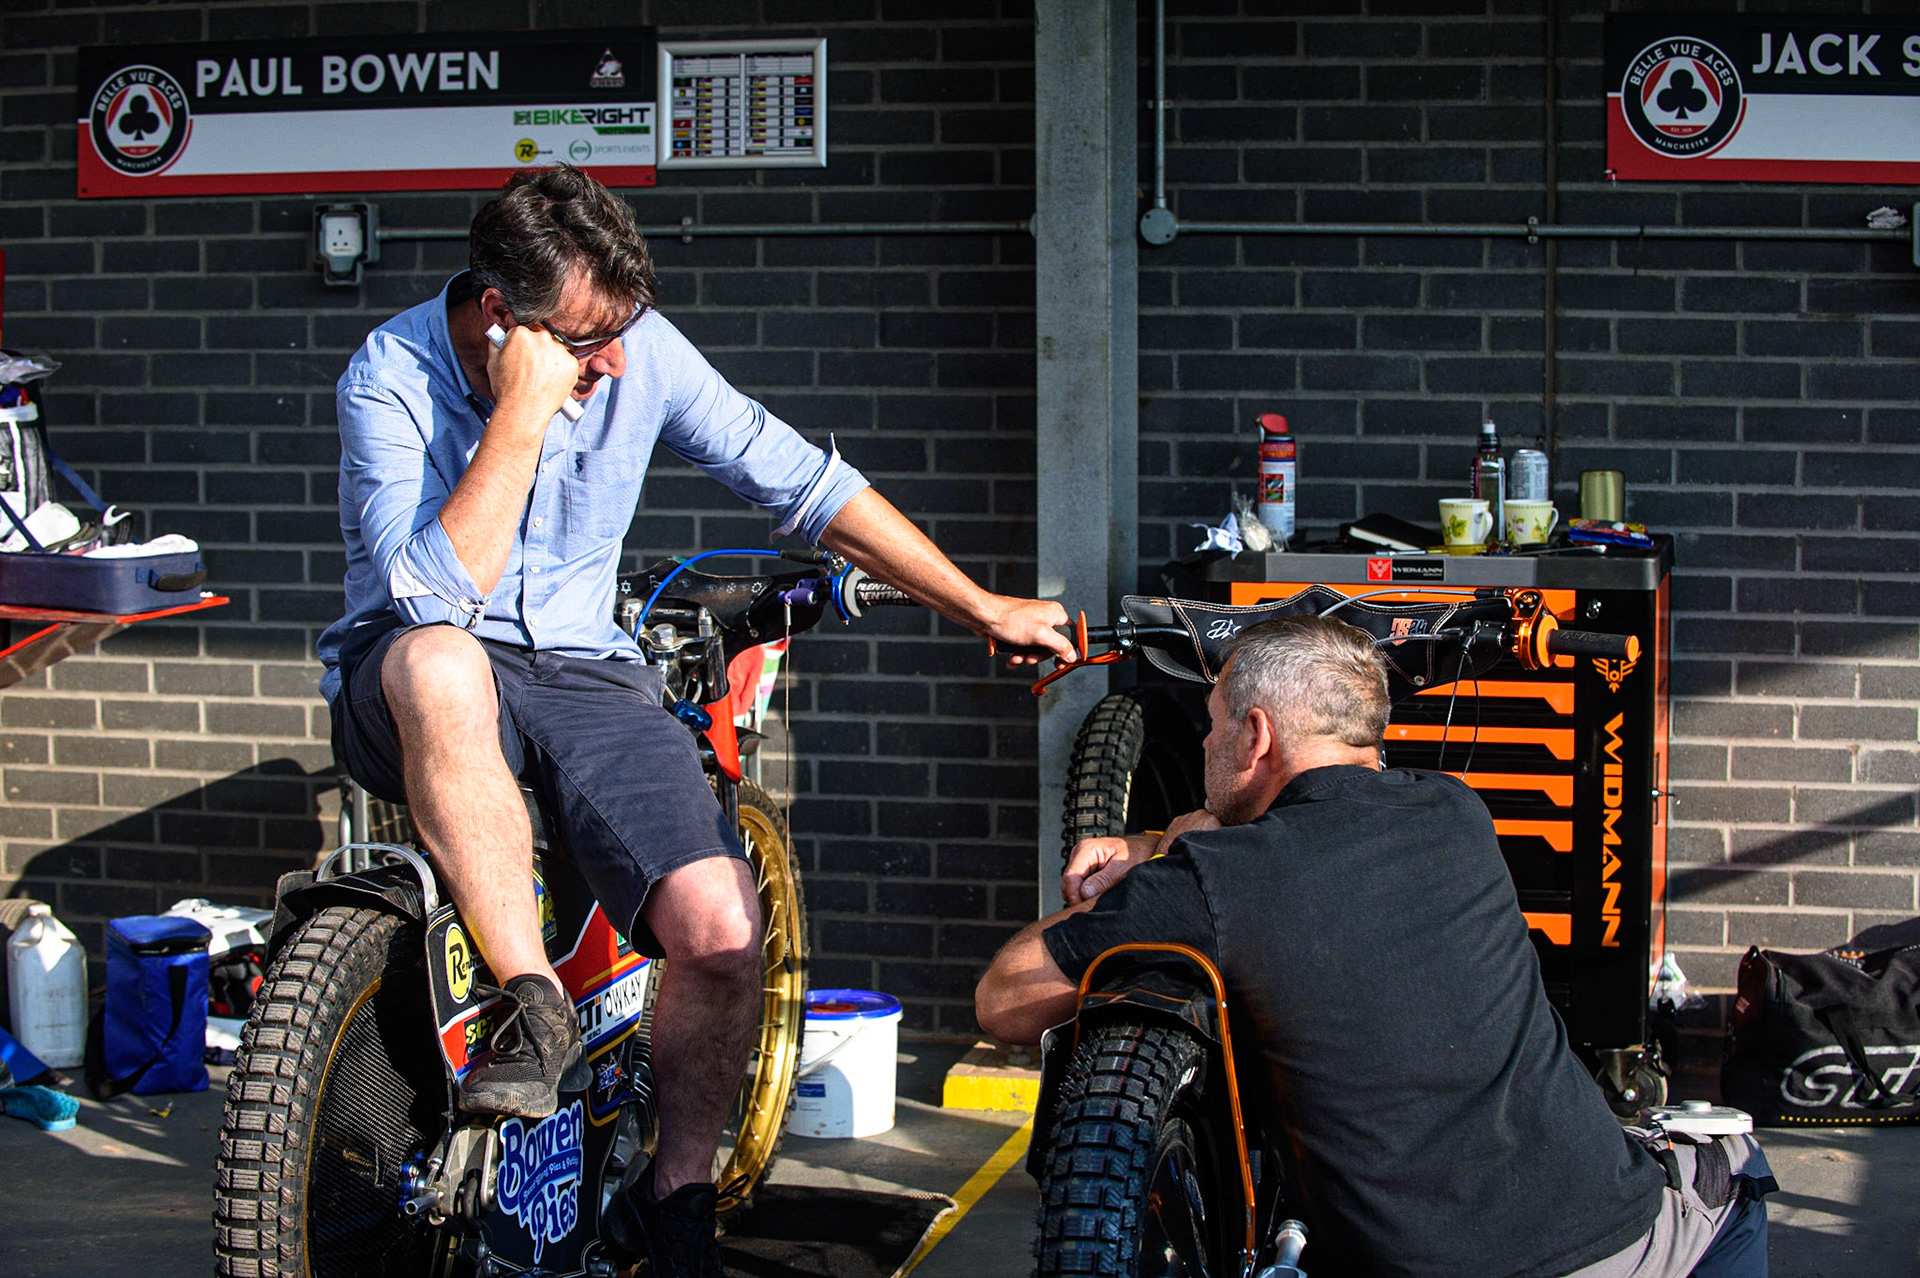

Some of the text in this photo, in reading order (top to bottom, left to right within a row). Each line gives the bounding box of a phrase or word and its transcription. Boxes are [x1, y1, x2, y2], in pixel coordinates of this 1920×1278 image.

[196, 51, 499, 98] PAUL BOWEN
[1630, 43, 1734, 86] BELLE VUE ACES
[1752, 32, 1881, 76] JACK
[96, 72, 182, 112] BELLE VUE ACES
[533, 107, 650, 125] BIKERIGHT
[1655, 136, 1710, 150] MANCHESTER
[1602, 712, 1623, 947] WIDMANN
[604, 973, 642, 1018] OWKAY
[498, 1100, 583, 1214] Bowen
[530, 1182, 577, 1263] Pies
